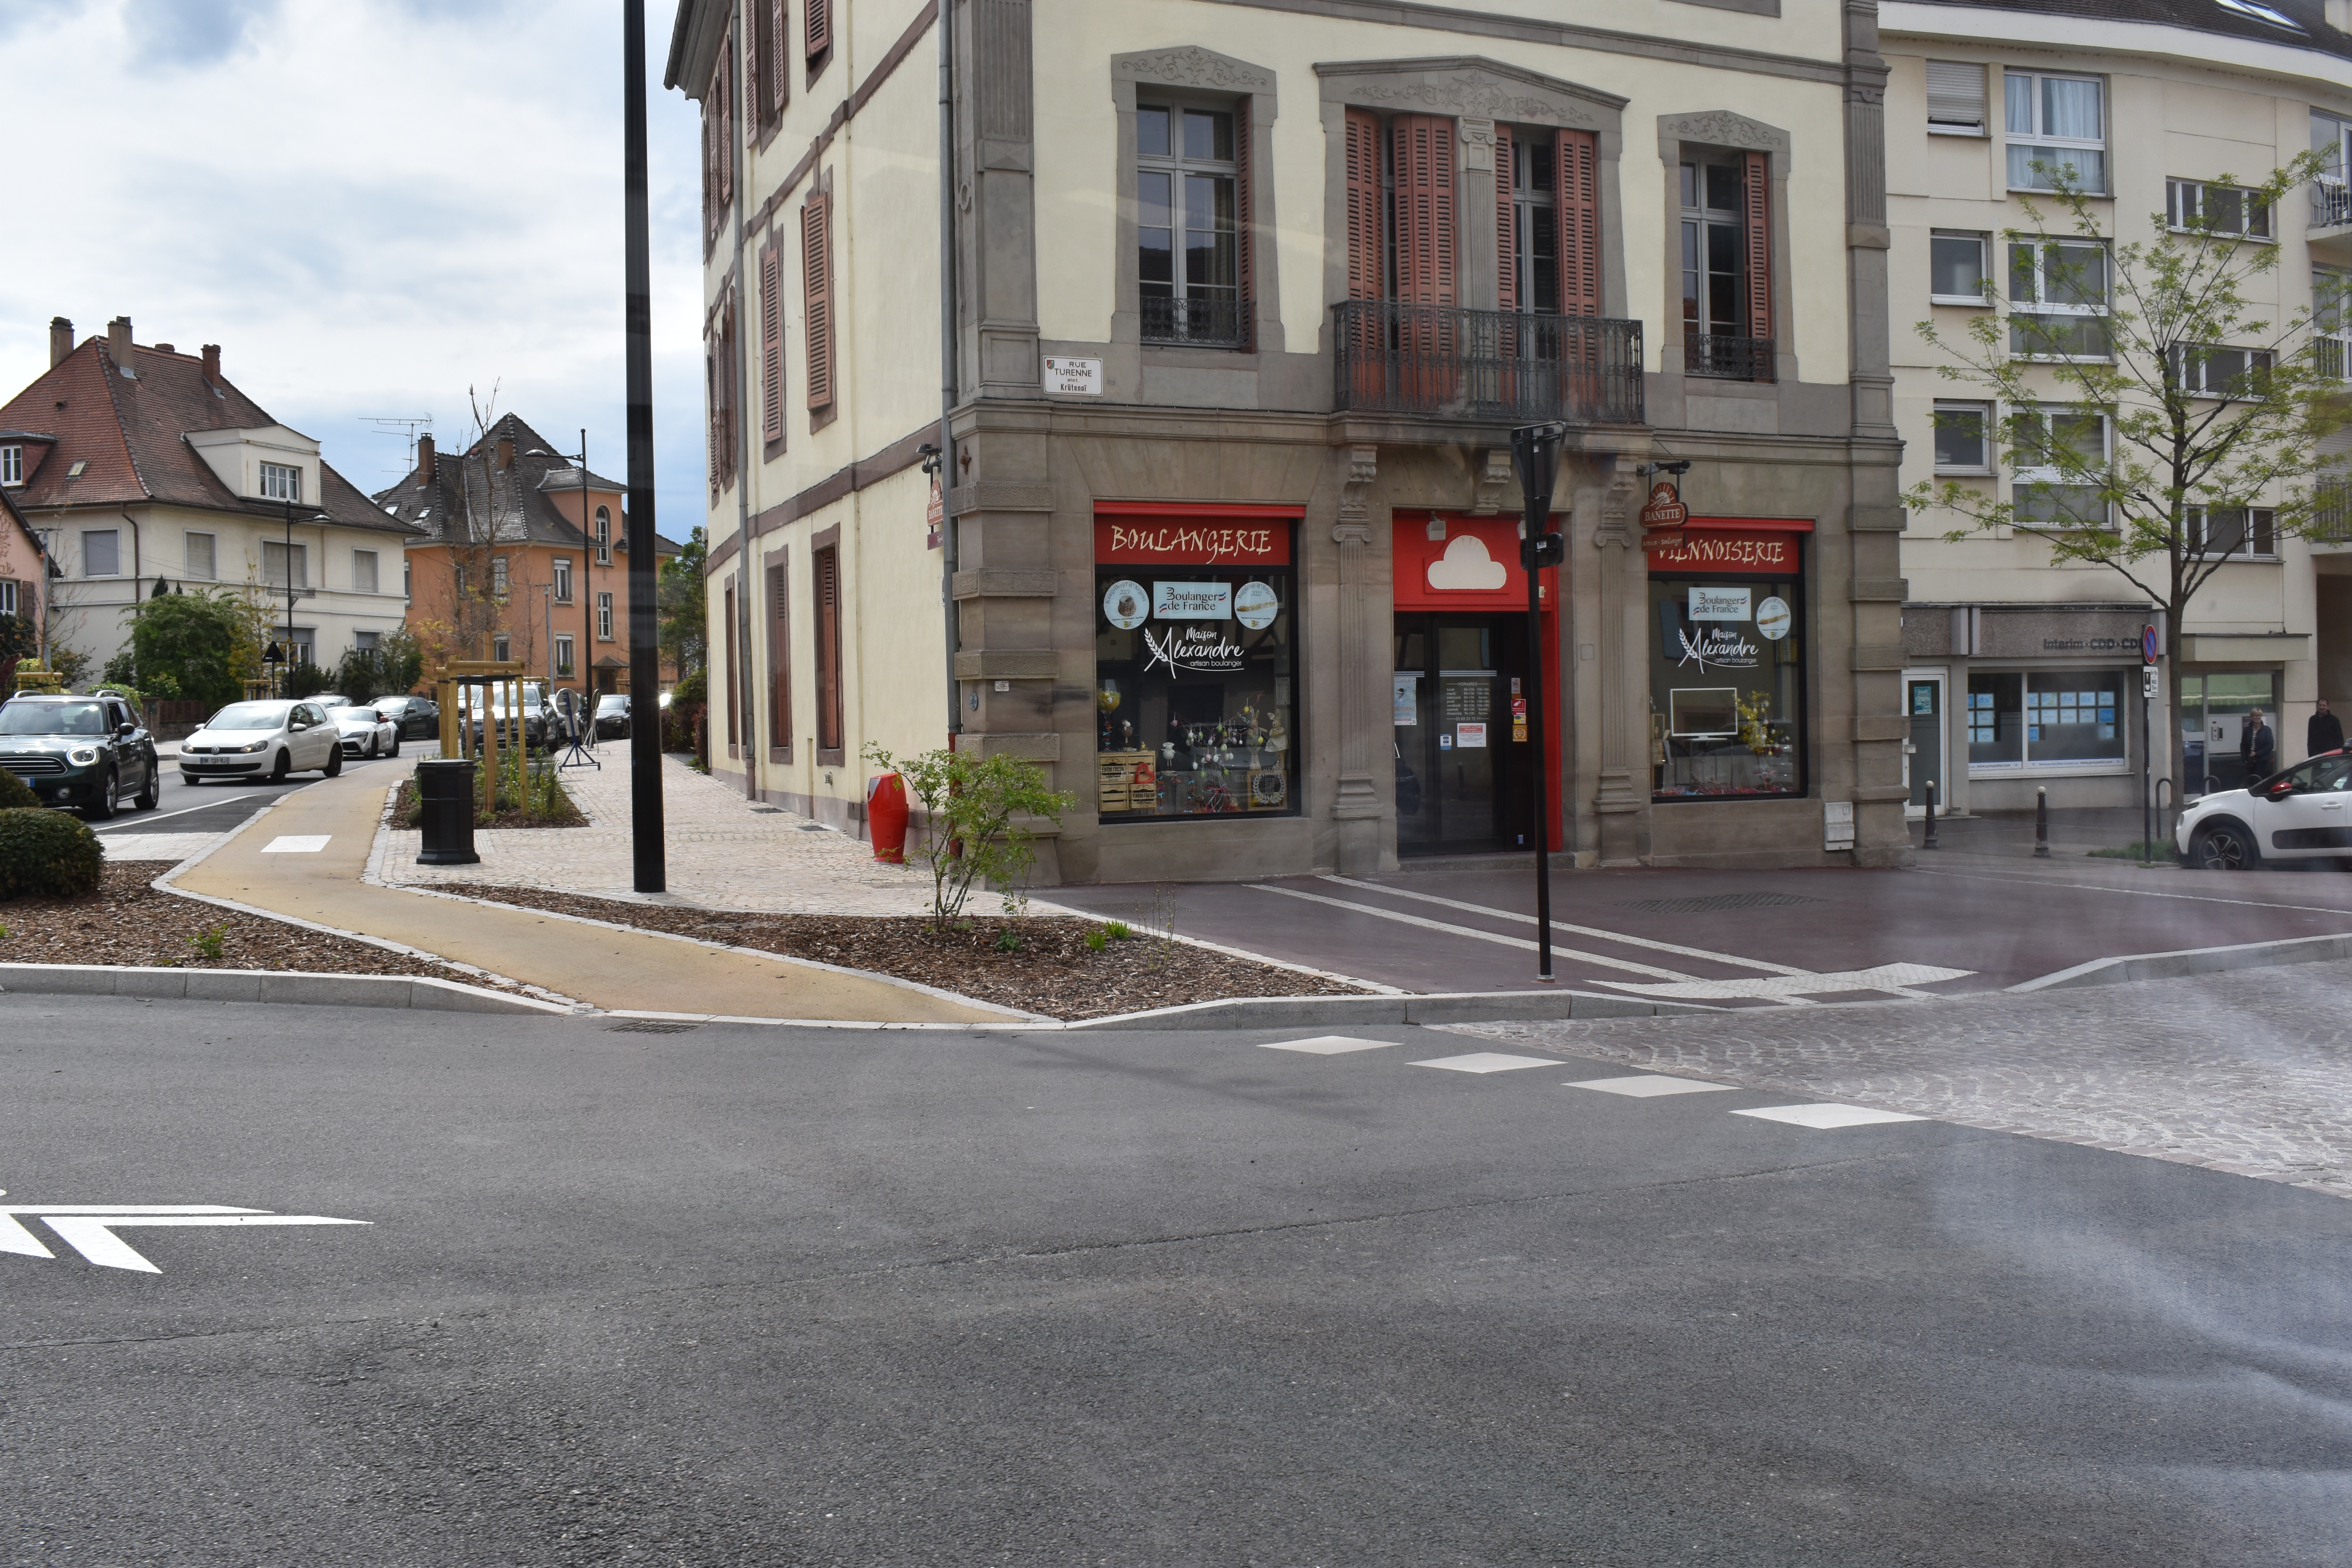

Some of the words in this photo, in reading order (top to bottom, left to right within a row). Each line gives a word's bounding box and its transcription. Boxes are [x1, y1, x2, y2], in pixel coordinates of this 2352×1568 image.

[1054, 368, 1092, 377] TURENNE
[1060, 383, 1087, 392] Krütenoï
[1645, 509, 1680, 521] BANETTE
[1111, 525, 1271, 564] BOULANGERIE
[1661, 537, 1682, 546] Boulanger
[1105, 582, 1128, 604] Kougelhopf
[1167, 587, 1218, 603] Boulanger
[1238, 584, 1256, 599] Baguette
[1168, 601, 1180, 610] de
[1183, 601, 1216, 610] France
[1699, 592, 1741, 607] Boulanger
[1186, 627, 1217, 642] Maison
[1712, 628, 1737, 641] Maison
[1678, 628, 1759, 674] Alexandre
[2090, 638, 2114, 650] CDD
[1144, 627, 1244, 679] Alexandre
